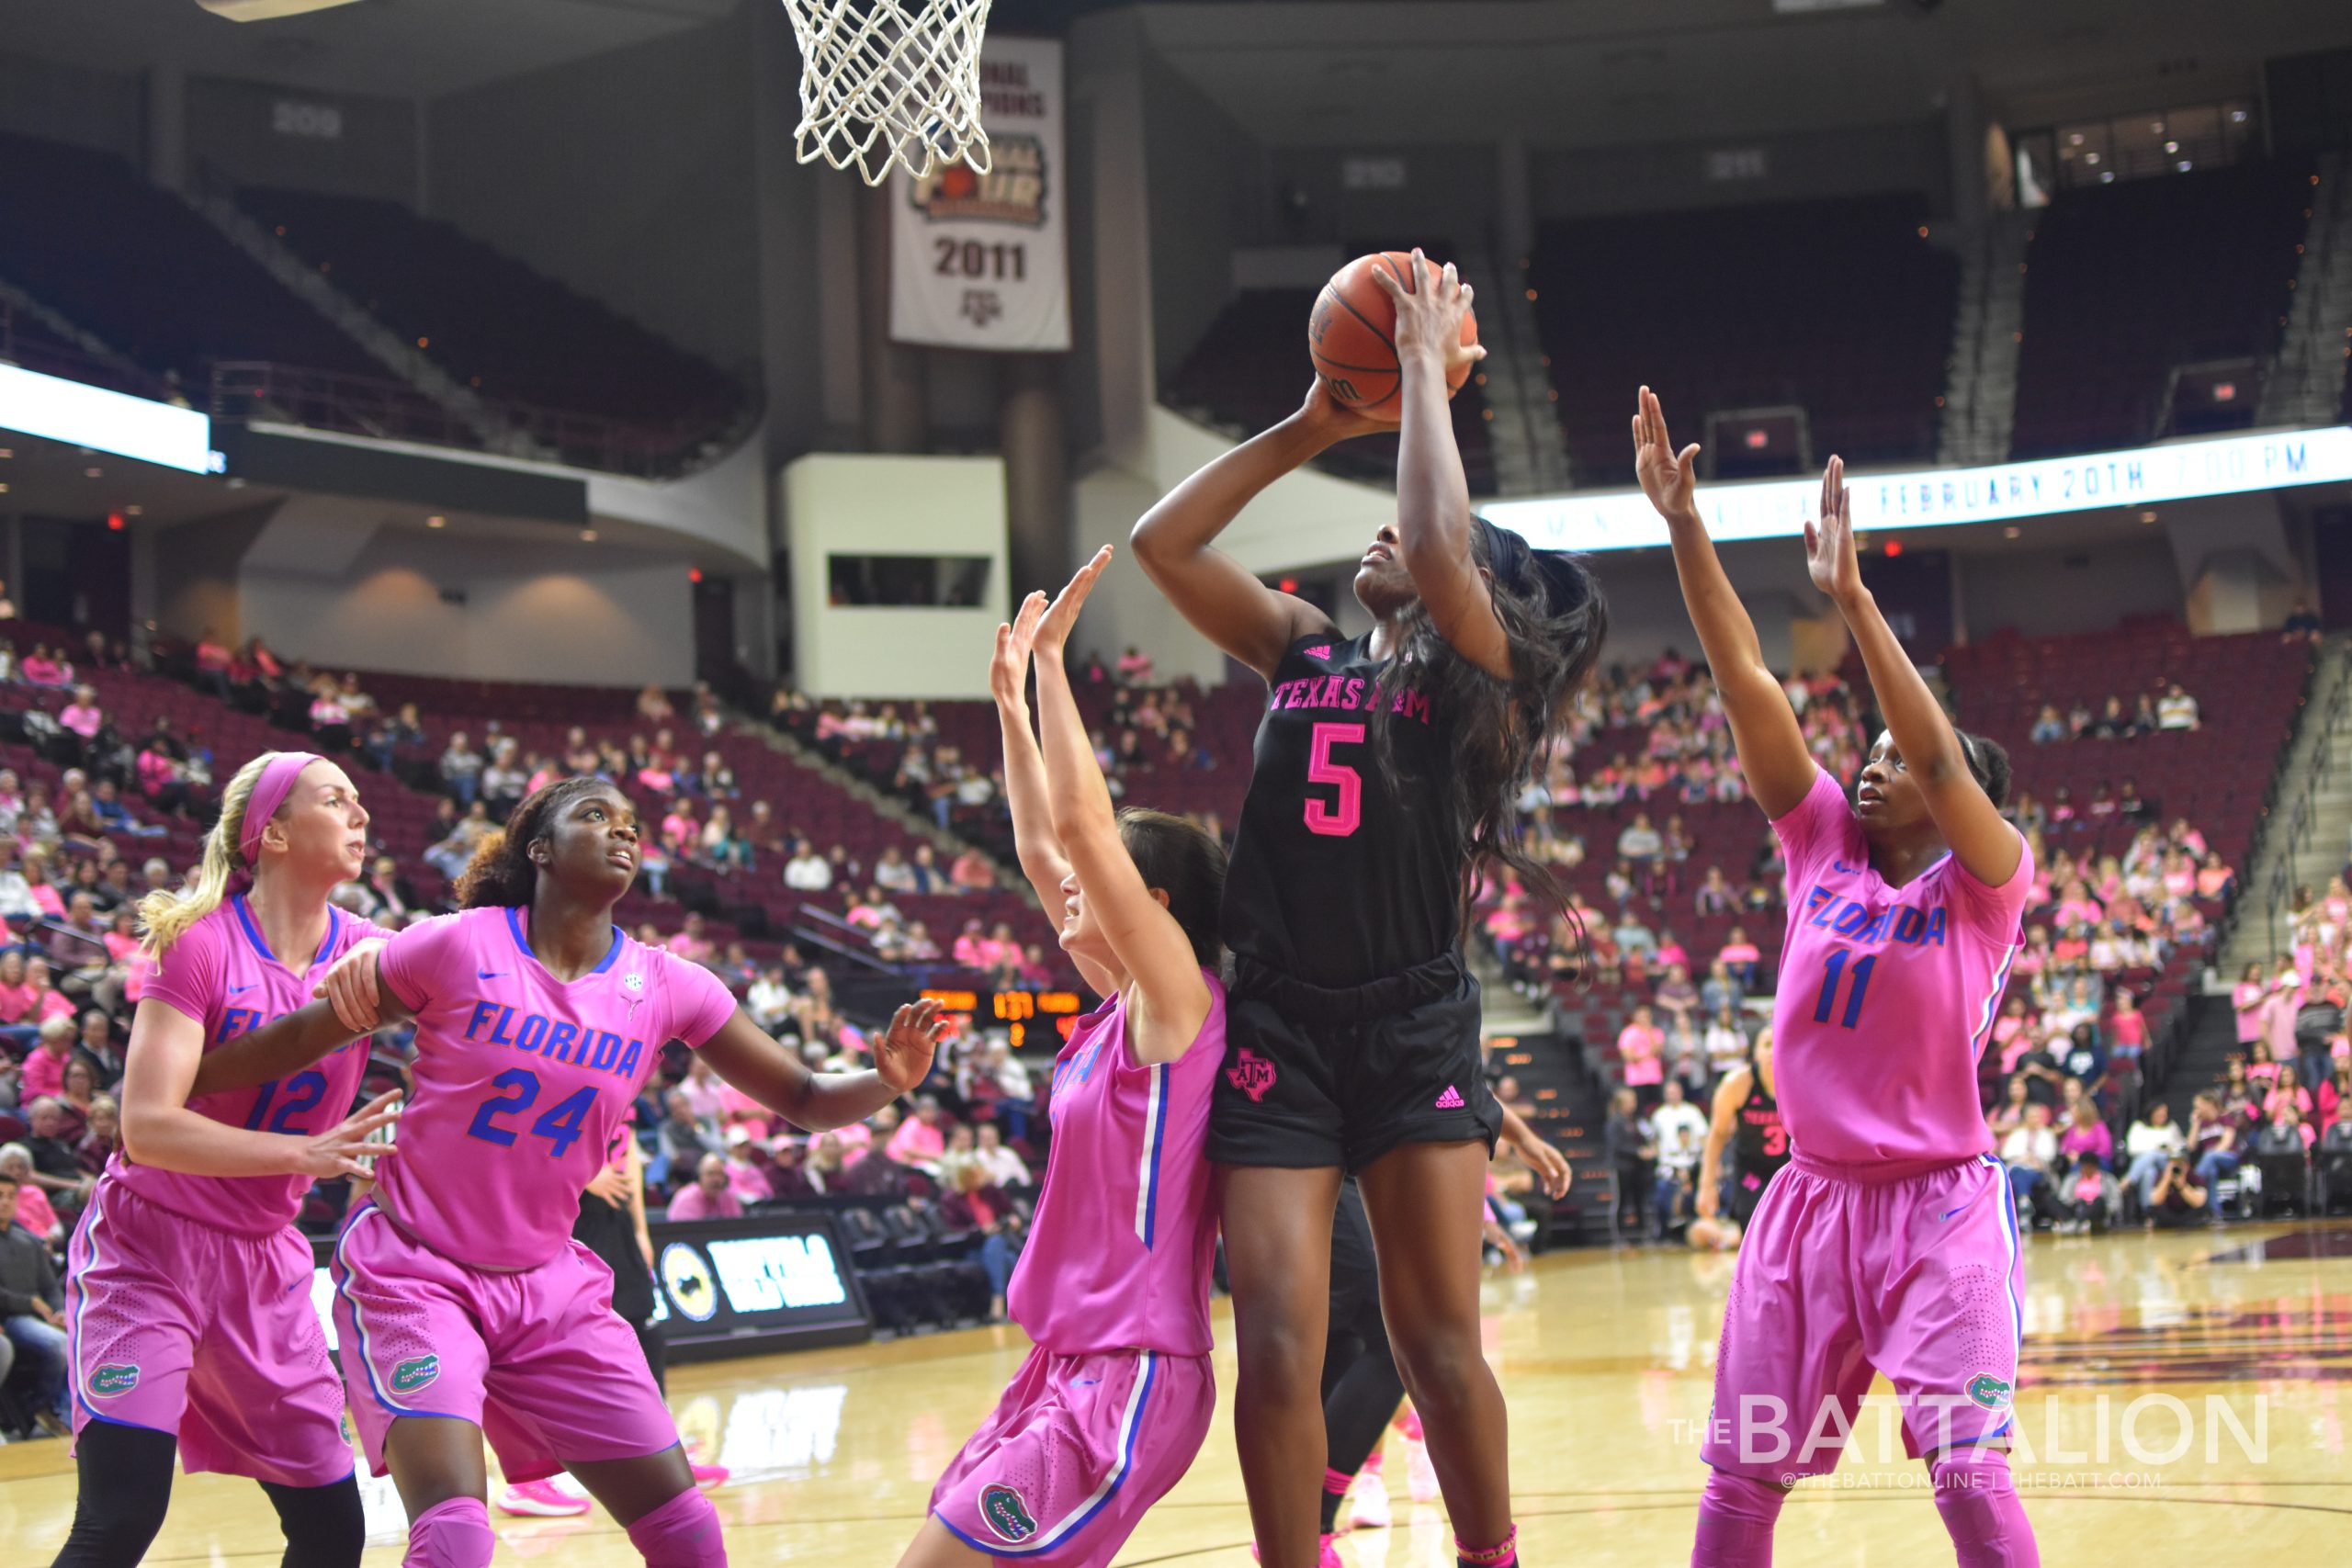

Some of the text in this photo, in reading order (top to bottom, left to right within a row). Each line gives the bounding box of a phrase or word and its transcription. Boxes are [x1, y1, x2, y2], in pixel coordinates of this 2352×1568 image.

[935, 236, 1026, 281] 2011
[1882, 474, 2042, 514] FEBRUARY
[2064, 461, 2143, 499] 20TH
[2264, 443, 2308, 475] PM
[1271, 675, 1365, 711] TEXAS
[1304, 722, 1365, 837] 5
[1807, 885, 1948, 949] FLORIDA
[1814, 948, 1878, 1030] 11
[464, 999, 643, 1079] FLORIDA
[244, 1070, 328, 1135] 12
[467, 1066, 600, 1159] 24
[1435, 1098, 1464, 1108] adidas
[1762, 1125, 1787, 1156] 3
